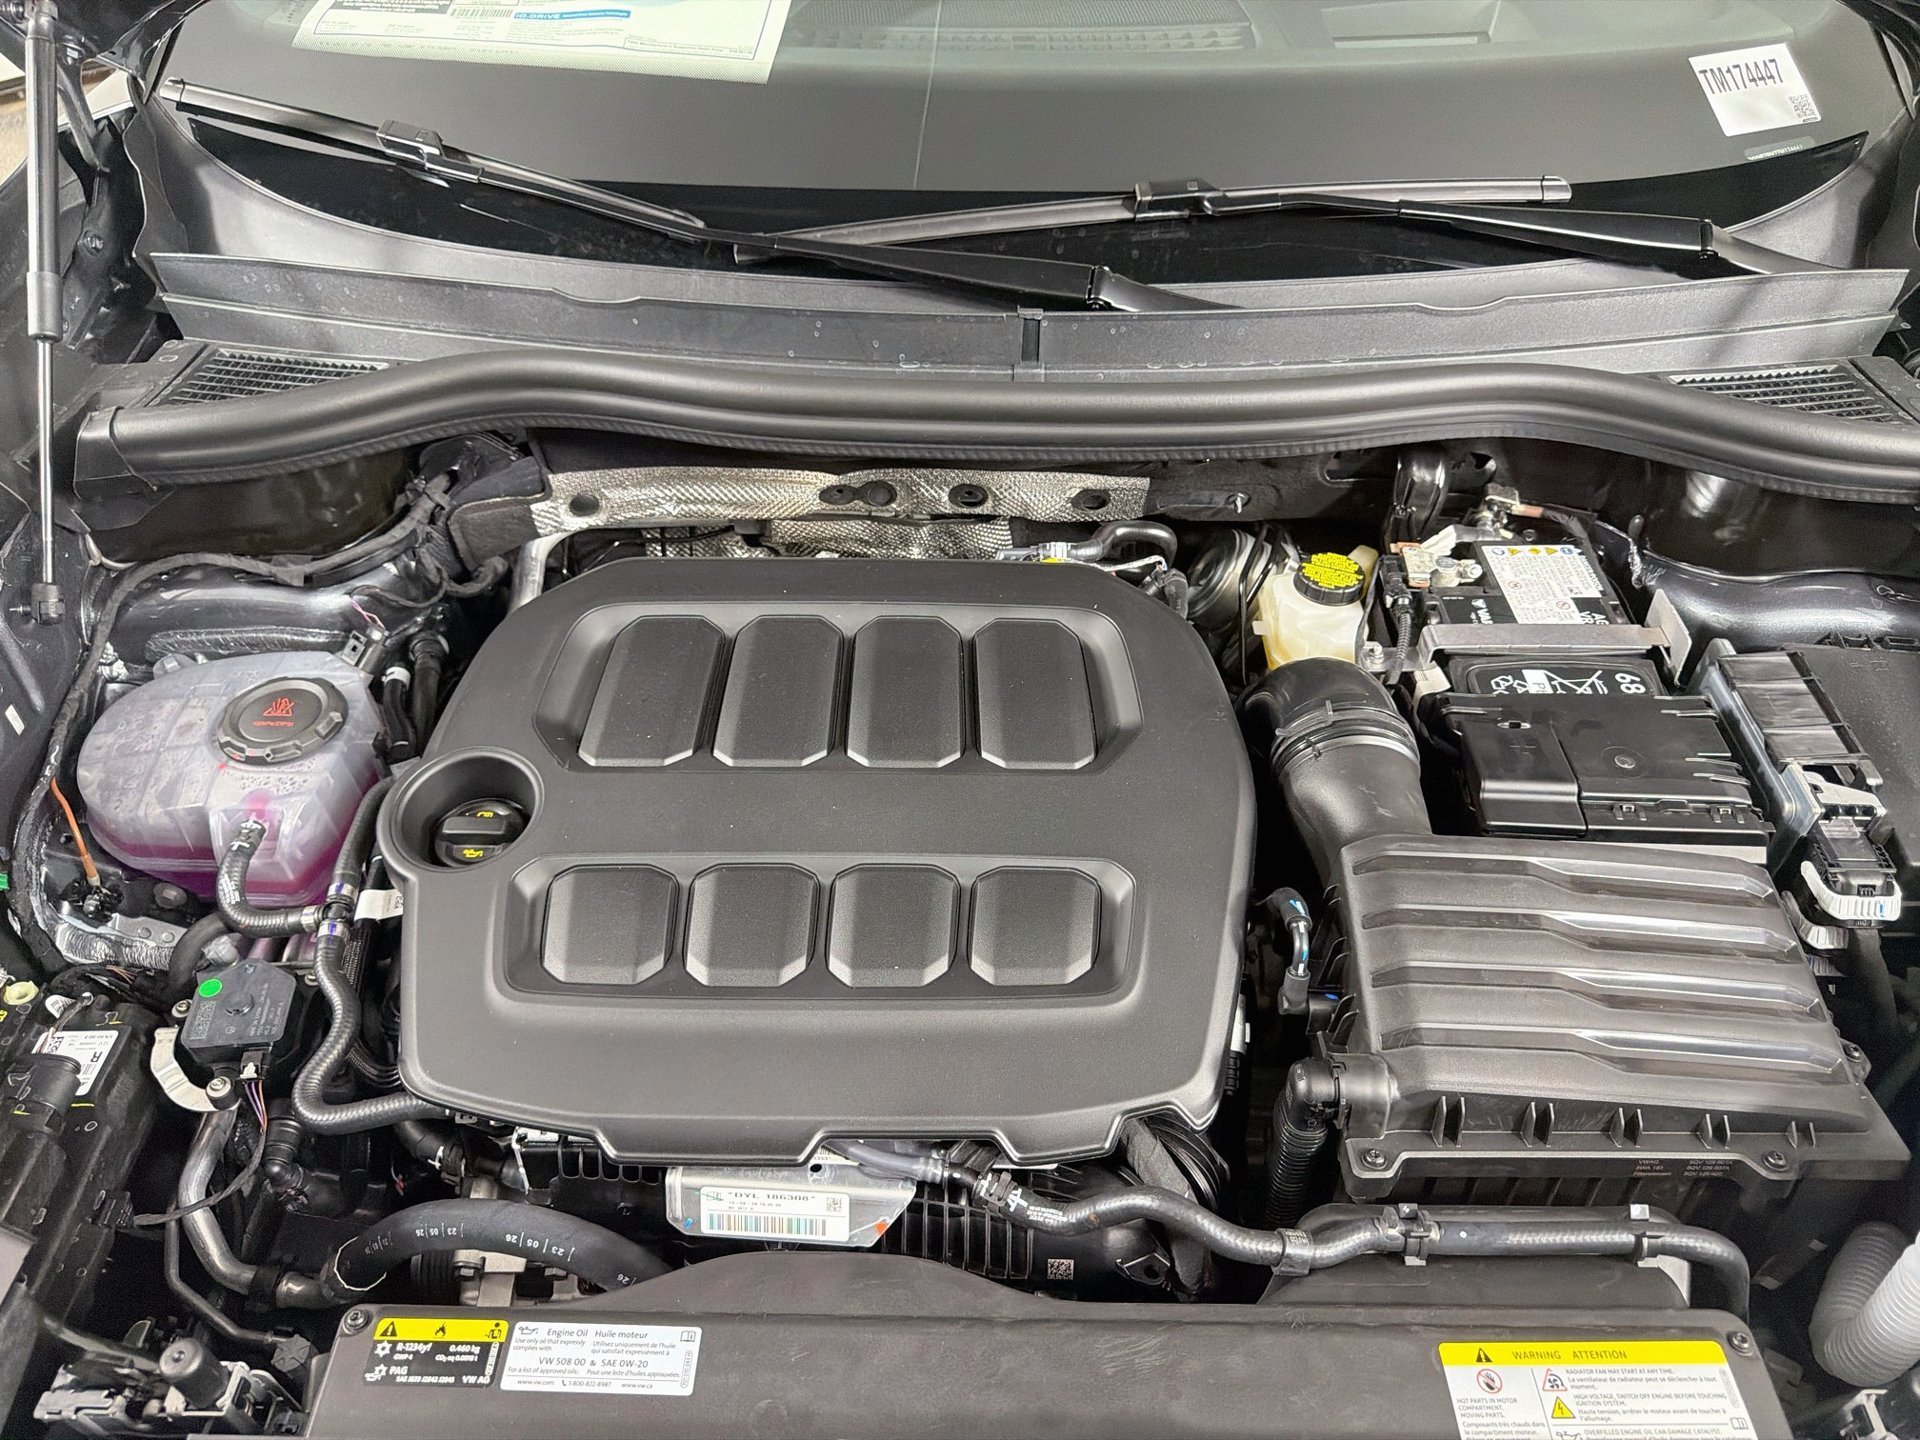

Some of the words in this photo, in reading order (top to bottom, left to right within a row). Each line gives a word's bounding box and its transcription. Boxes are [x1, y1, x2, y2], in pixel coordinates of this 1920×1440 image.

[1698, 58, 1784, 95] TM174447
[1614, 672, 1646, 694] 68
[90, 1051, 103, 1063] R
[415, 1228, 424, 1237] 26
[429, 1228, 439, 1236] 05
[447, 1227, 457, 1235] 23
[505, 1234, 518, 1244] 26
[526, 1238, 539, 1249] 05
[552, 1246, 565, 1257] 23
[617, 1273, 630, 1284] 26
[547, 1328, 574, 1338] Engine
[576, 1329, 588, 1337] Oil
[594, 1330, 616, 1338] Huile
[618, 1331, 648, 1339] moteur
[396, 1342, 433, 1353] R-1234yf
[449, 1344, 471, 1353] 0.460
[471, 1345, 481, 1354] kg
[1512, 1350, 1562, 1360] WARNING
[1572, 1350, 1628, 1360] ATTENTION
[538, 1357, 555, 1365] VW
[556, 1358, 572, 1366] 508
[574, 1358, 586, 1366] 00
[600, 1359, 618, 1367] SAE
[619, 1360, 648, 1368] 0W-20
[388, 1366, 409, 1376] PAG
[462, 1376, 476, 1384] VW
[476, 1376, 491, 1384] AG
[1644, 1376, 1659, 1384] peut
[1584, 1428, 1620, 1436] OVERFILLED
